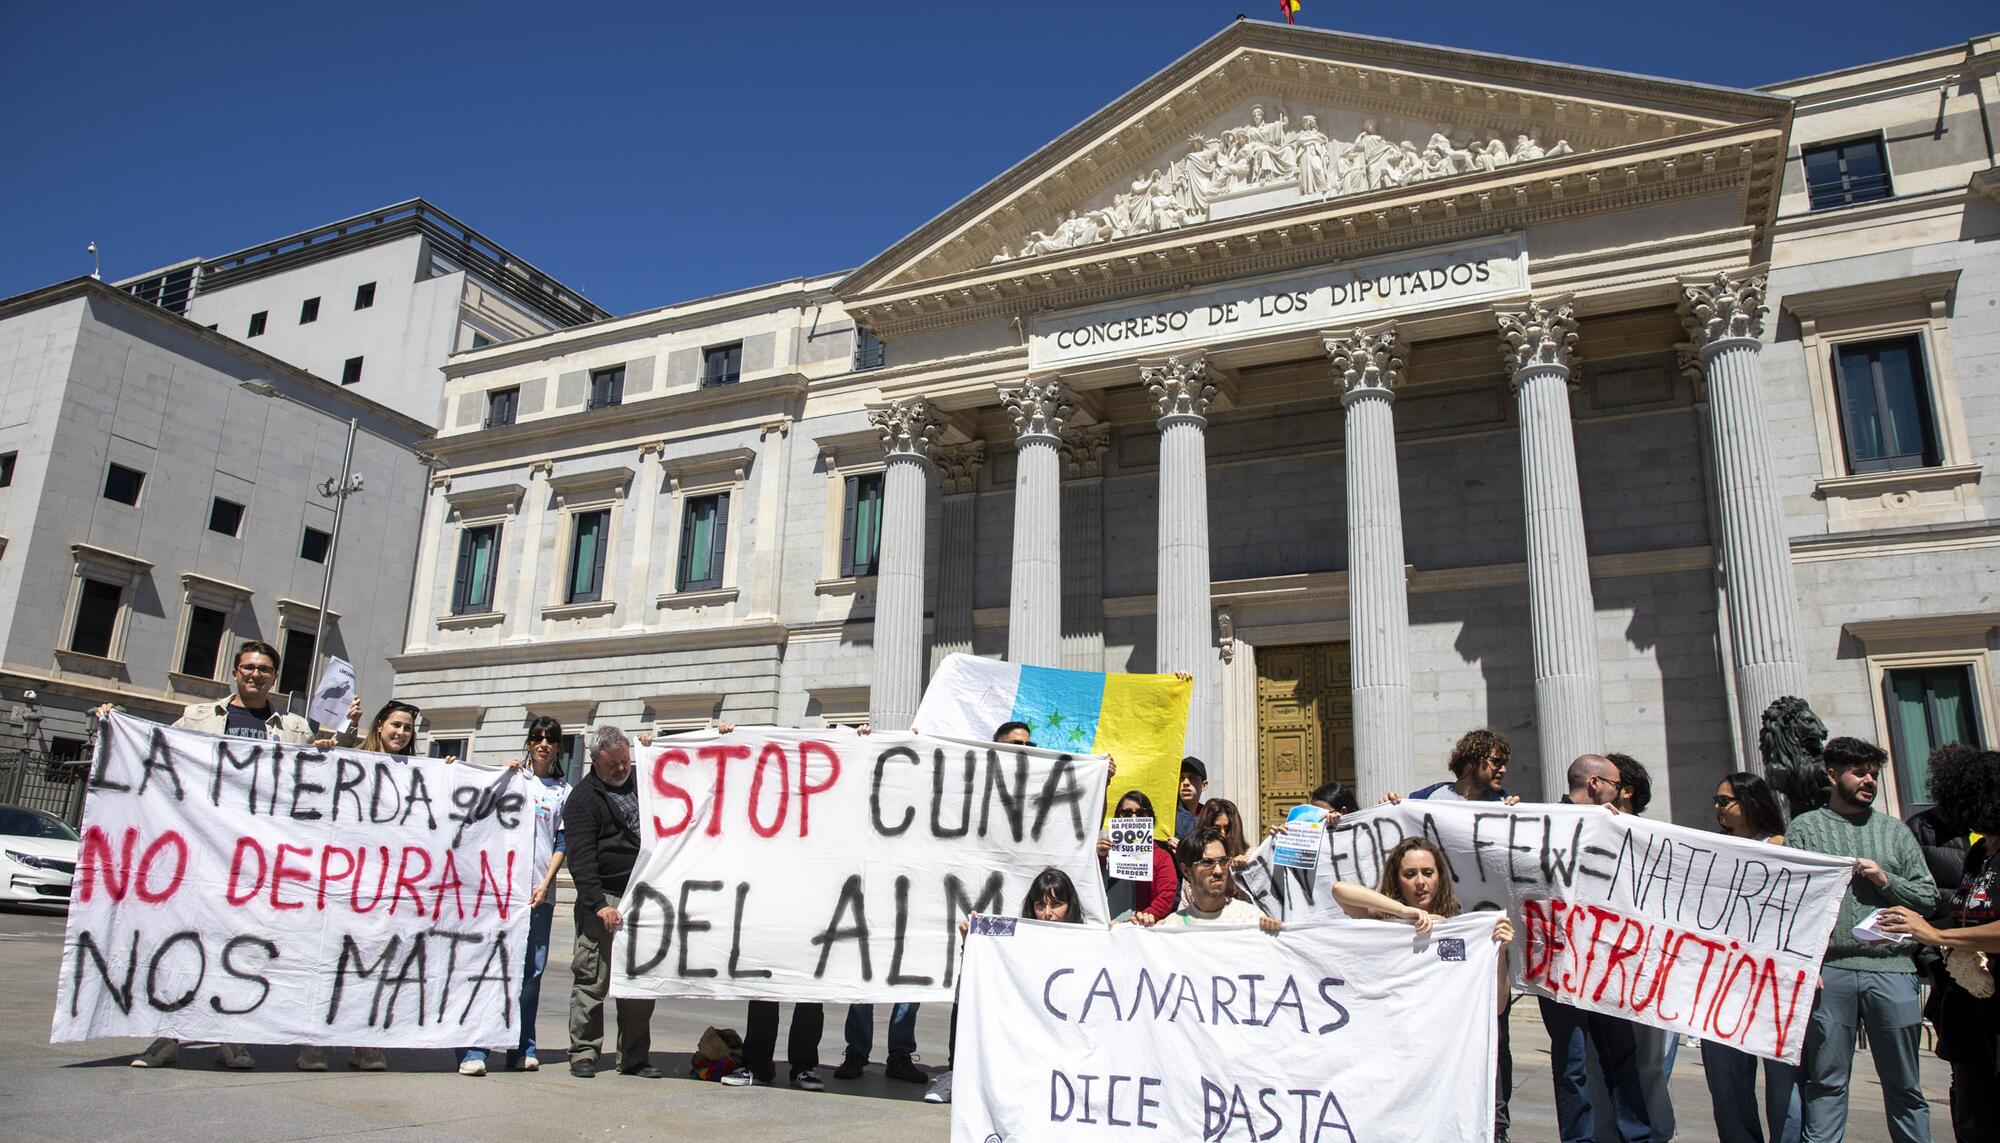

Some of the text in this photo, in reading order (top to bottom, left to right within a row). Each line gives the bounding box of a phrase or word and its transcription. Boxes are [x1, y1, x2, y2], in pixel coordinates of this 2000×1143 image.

[1056, 260, 1491, 350] CONGRESO DE LOS DIPUTADOS
[90, 720, 527, 849] LA MIERDA que
[652, 740, 1087, 843] STOP CUNA
[79, 824, 516, 921] NO DEPURAN
[1111, 830, 1153, 844] 90%
[1325, 817, 1405, 891] FOR
[1473, 813, 1585, 888] FEW
[1606, 827, 1813, 959] NATURAL
[626, 871, 1004, 988] DEL ALM
[70, 929, 513, 1029] NOS MATA
[1043, 967, 1350, 1036] CANARIAS
[1050, 1069, 1358, 1143] DICE BASTA
